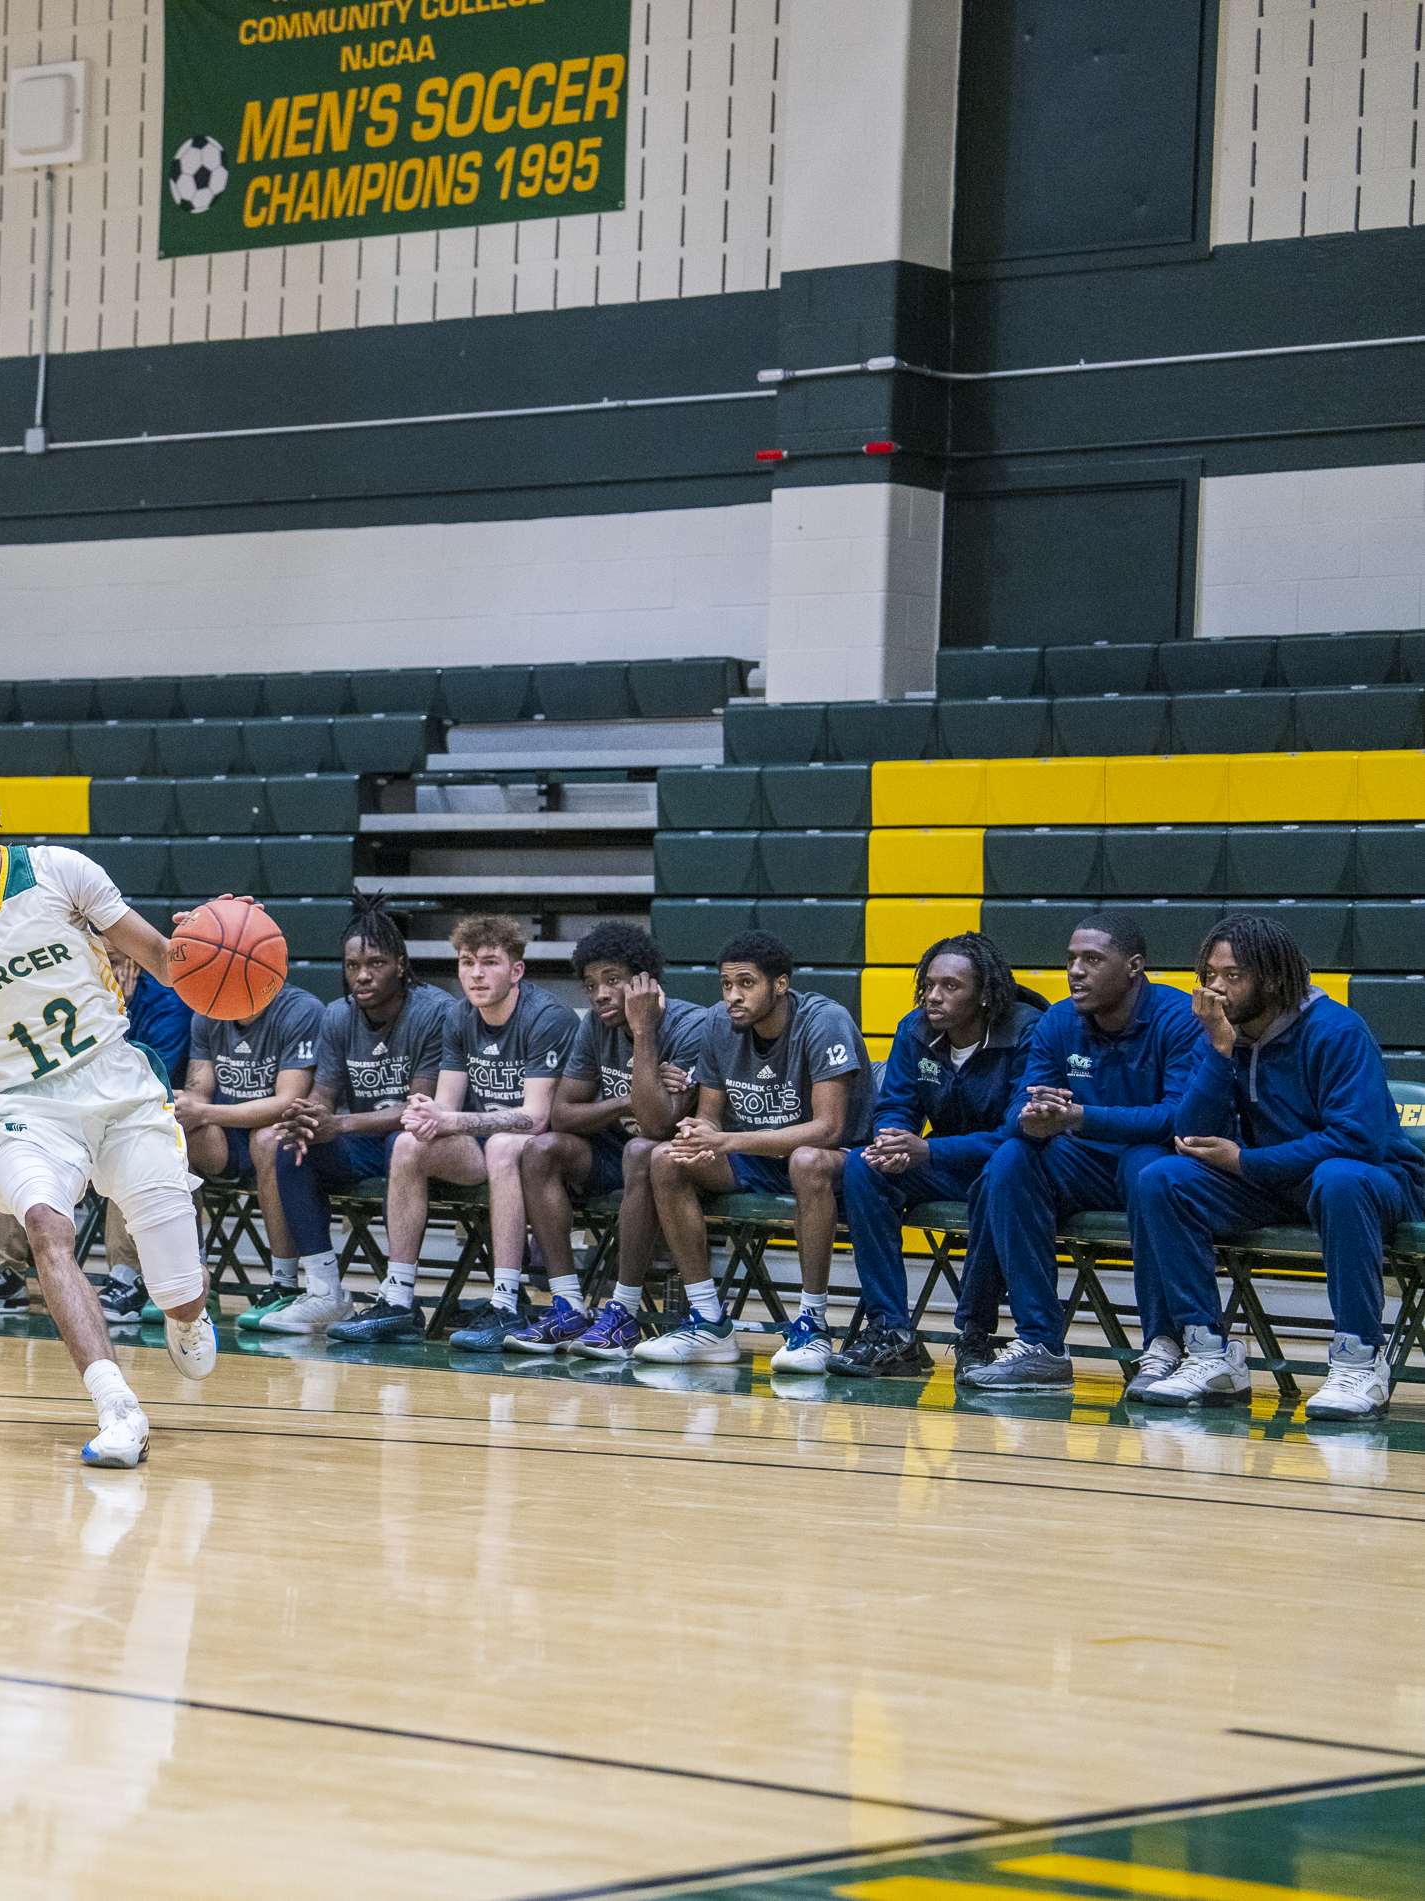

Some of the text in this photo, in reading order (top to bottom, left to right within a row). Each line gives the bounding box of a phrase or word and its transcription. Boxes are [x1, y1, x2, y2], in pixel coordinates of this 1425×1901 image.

[239, 0, 412, 45] COMMUNITY
[340, 35, 435, 72] NJCAA
[237, 54, 625, 164] MEN'S SOCCER
[244, 137, 603, 228] CHAMPIONS 1995
[8, 996, 99, 1080] 12
[298, 1040, 313, 1059] 11
[826, 1044, 848, 1066] 12
